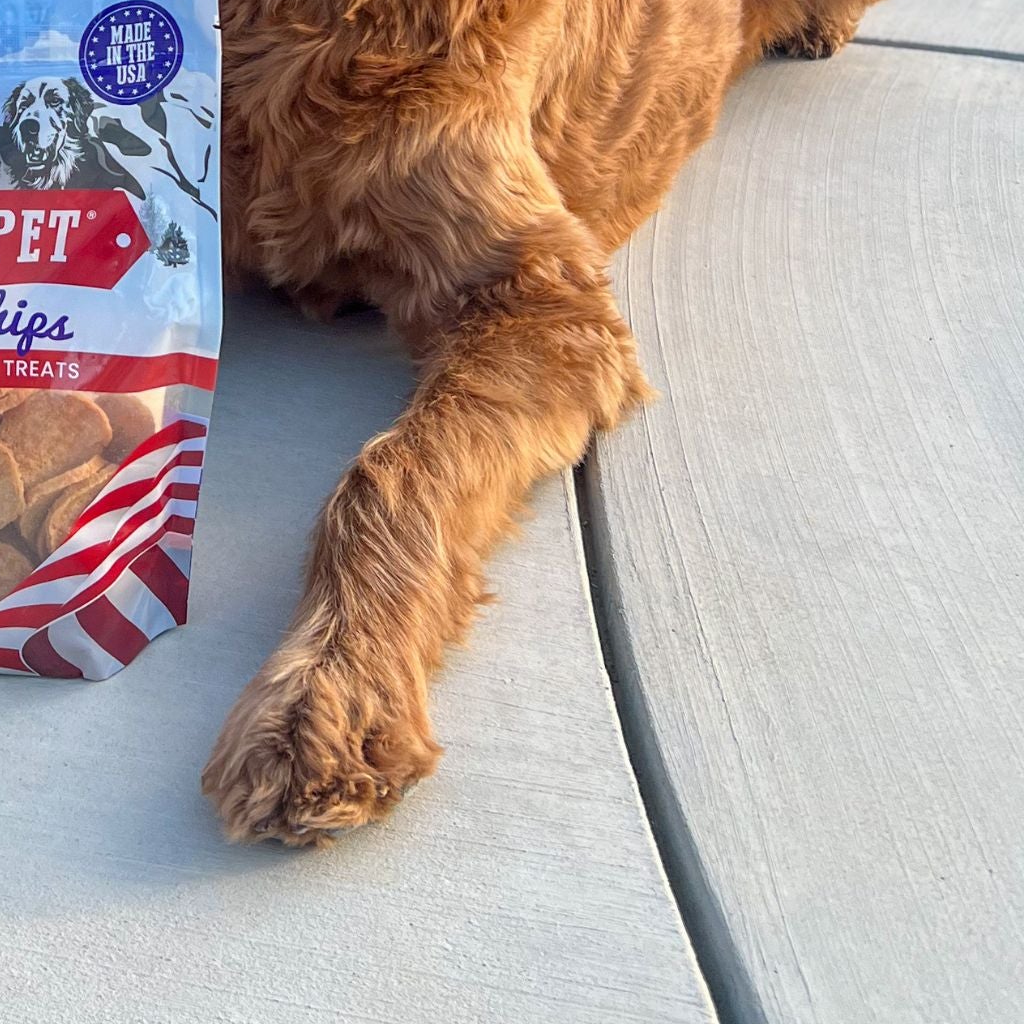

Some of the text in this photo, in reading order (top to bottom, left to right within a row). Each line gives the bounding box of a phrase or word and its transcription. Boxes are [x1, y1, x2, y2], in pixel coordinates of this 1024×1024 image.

[110, 21, 152, 46] MADE
[106, 41, 156, 66] IN THE
[116, 62, 147, 86] USA
[3, 359, 80, 380] TREATS
